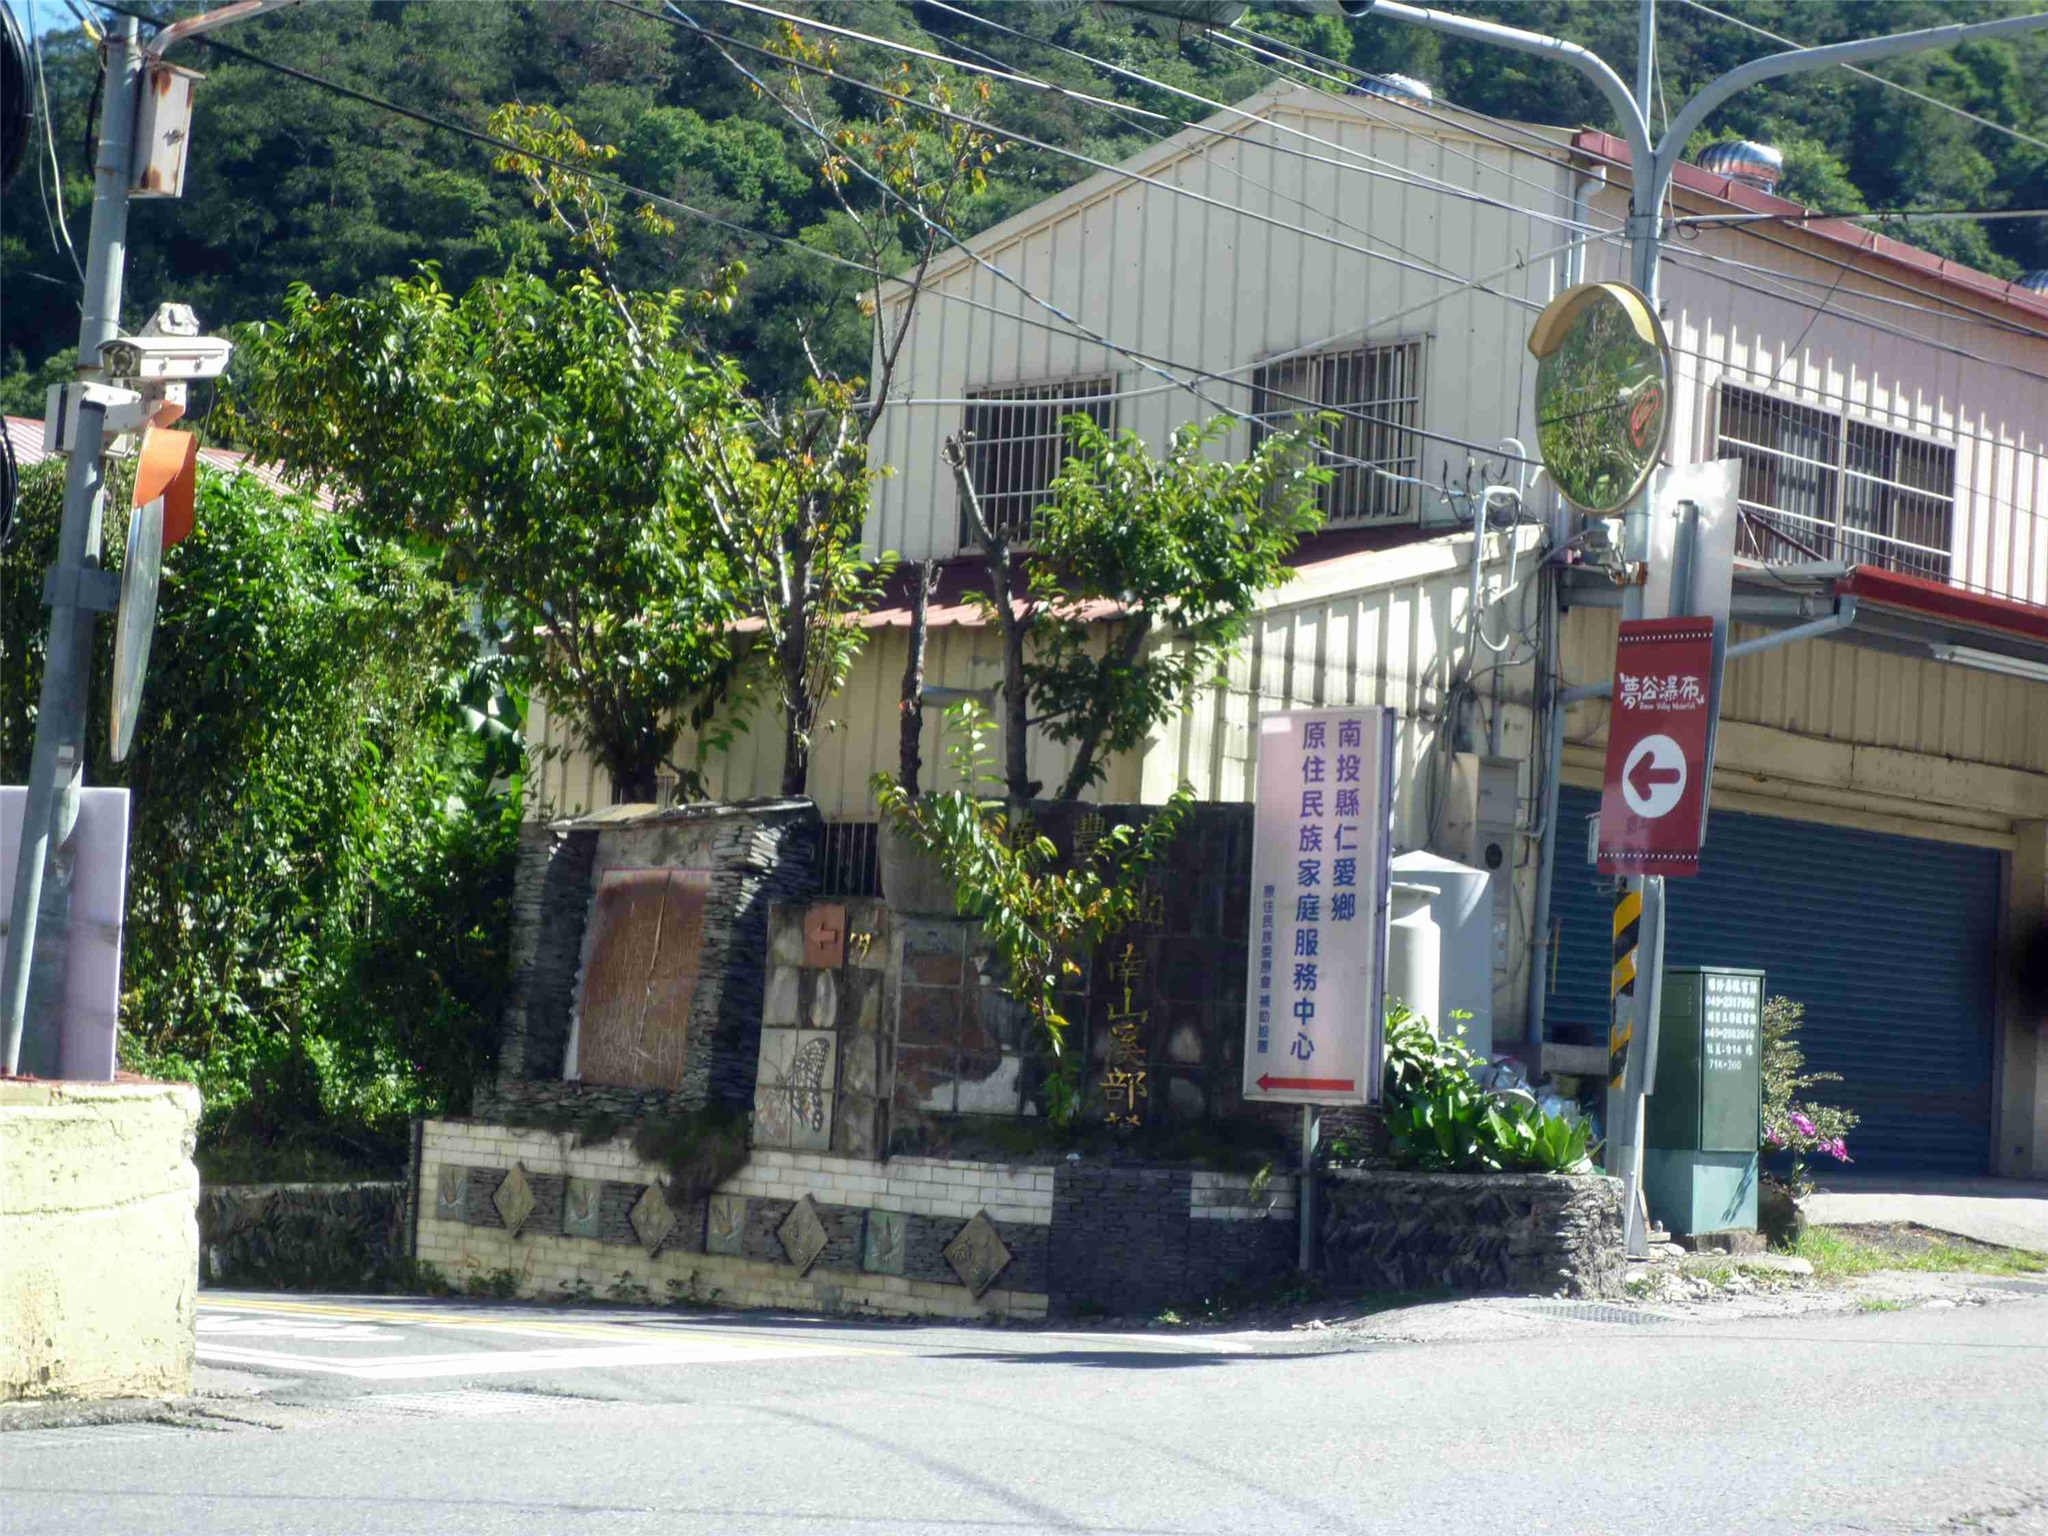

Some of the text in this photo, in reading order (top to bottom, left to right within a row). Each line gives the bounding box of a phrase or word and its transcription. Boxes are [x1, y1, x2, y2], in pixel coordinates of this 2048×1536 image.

[1619, 672, 1705, 710] 夢谷瀑布
[1290, 721, 1327, 1061] 原住民族家庭服務中心
[1331, 718, 1361, 922] 南投縣仁愛鄉
